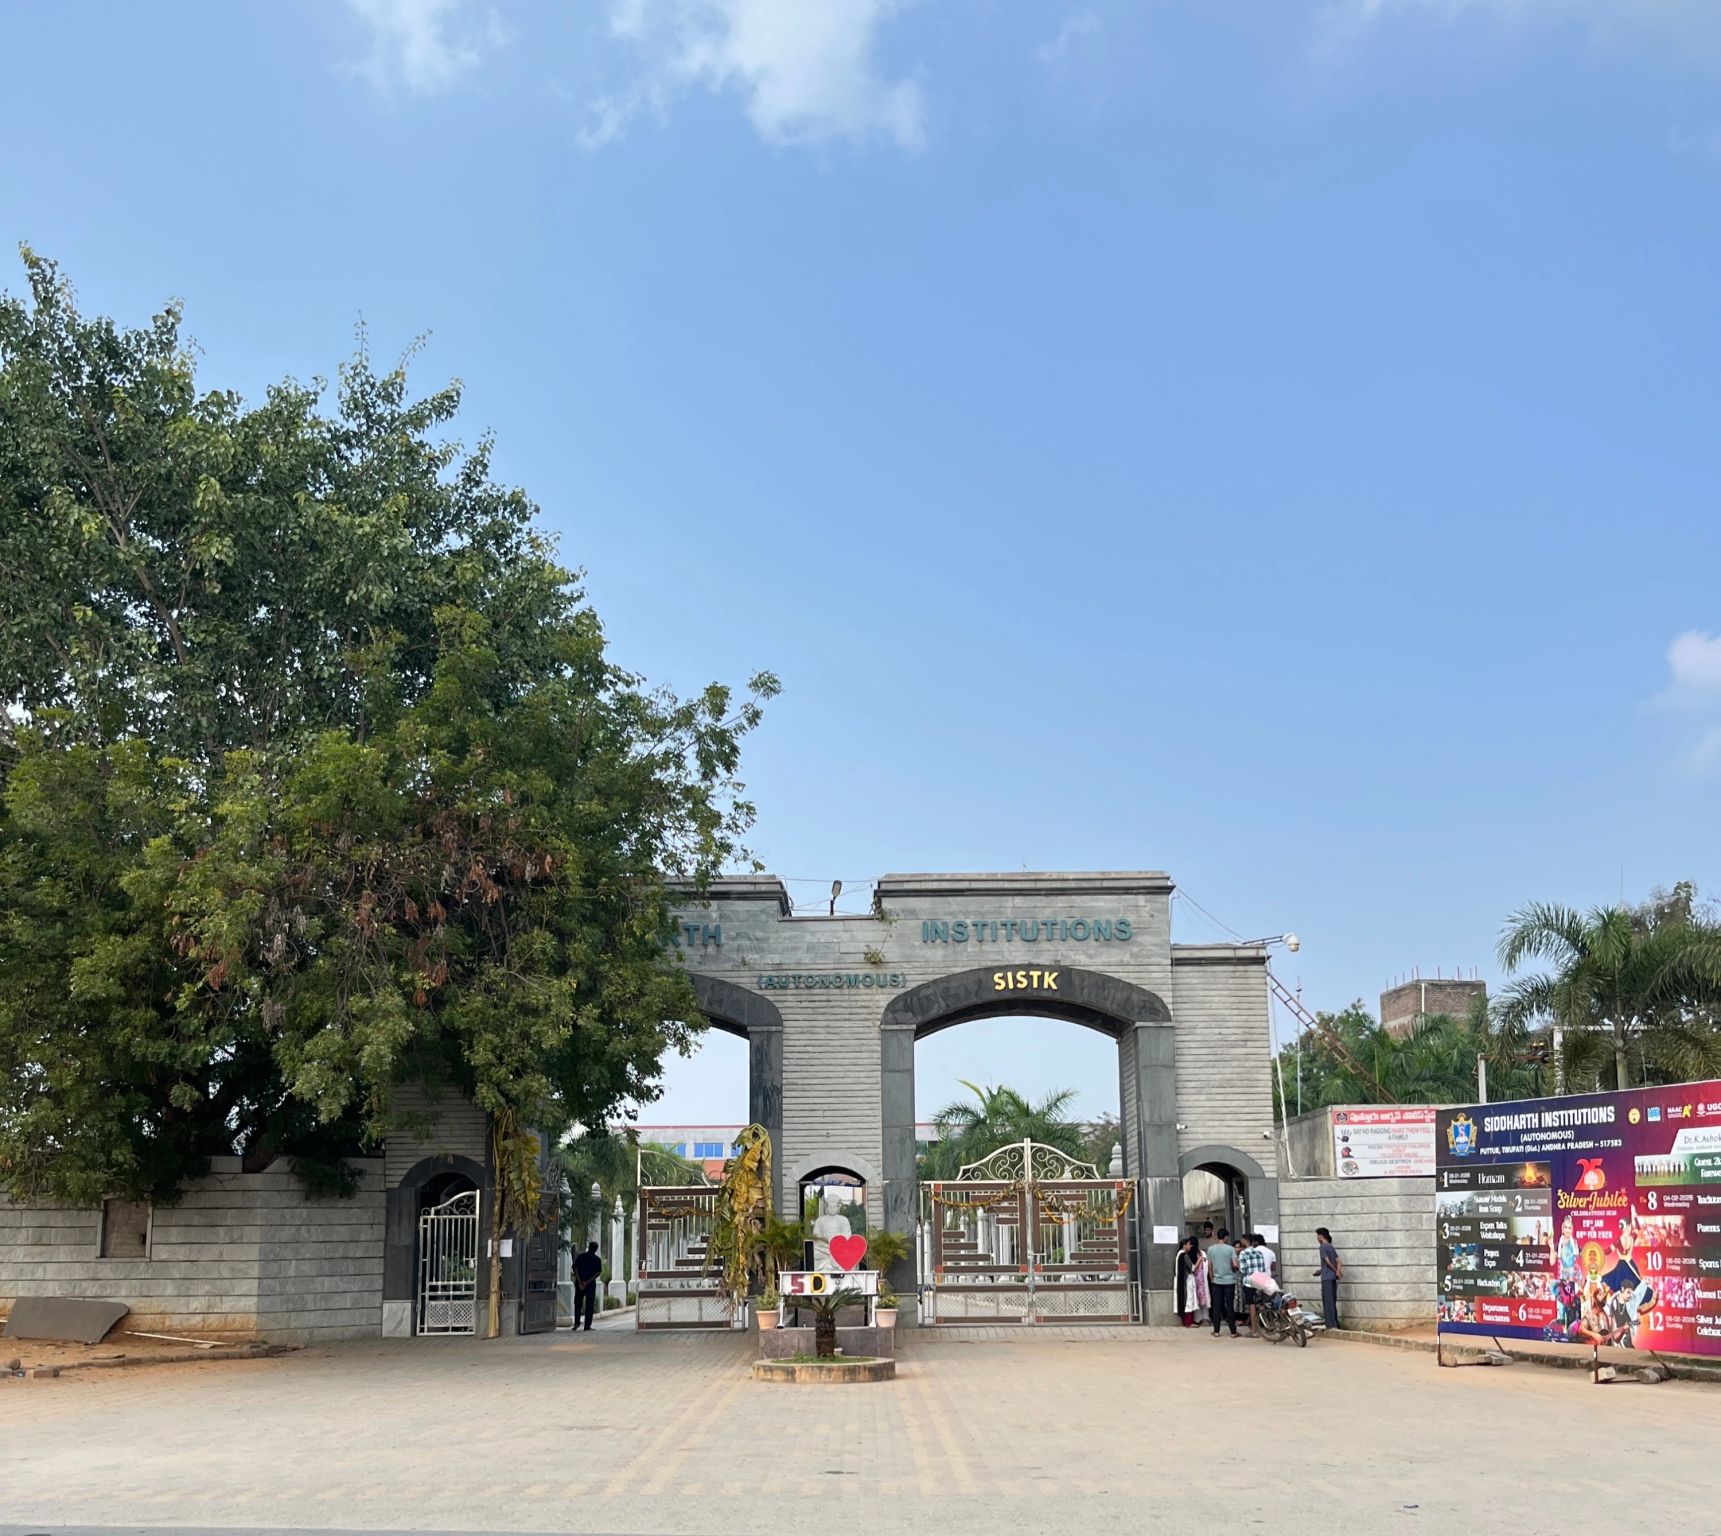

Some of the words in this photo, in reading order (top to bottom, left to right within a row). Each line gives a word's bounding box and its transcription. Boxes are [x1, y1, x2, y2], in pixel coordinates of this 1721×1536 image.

[921, 918, 1132, 943] INSTITUTIONS
[757, 973, 907, 989] (AUTONOMOUS)
[993, 970, 1059, 991] SISTK
[1484, 1112, 1539, 1132] SIDDHARTH
[1541, 1106, 1615, 1127] INSTITUTIONS
[1520, 1130, 1574, 1143] (AUTONOMOUS)
[1541, 1143, 1566, 1152] ANDHRA
[1567, 1141, 1593, 1150] PRADESH
[1443, 1171, 1449, 1188] 1
[1574, 1158, 1605, 1190] 25
[1514, 1195, 1523, 1212] 2
[1557, 1190, 1589, 1209] Silver
[1589, 1191, 1628, 1210] Jubilee
[1648, 1191, 1657, 1210] 8
[1442, 1223, 1449, 1239] 3
[1516, 1249, 1524, 1267] 4
[1646, 1251, 1662, 1271] 10
[1444, 1275, 1451, 1291] 5
[1519, 1304, 1526, 1321] 6
[1648, 1311, 1664, 1331] 12
